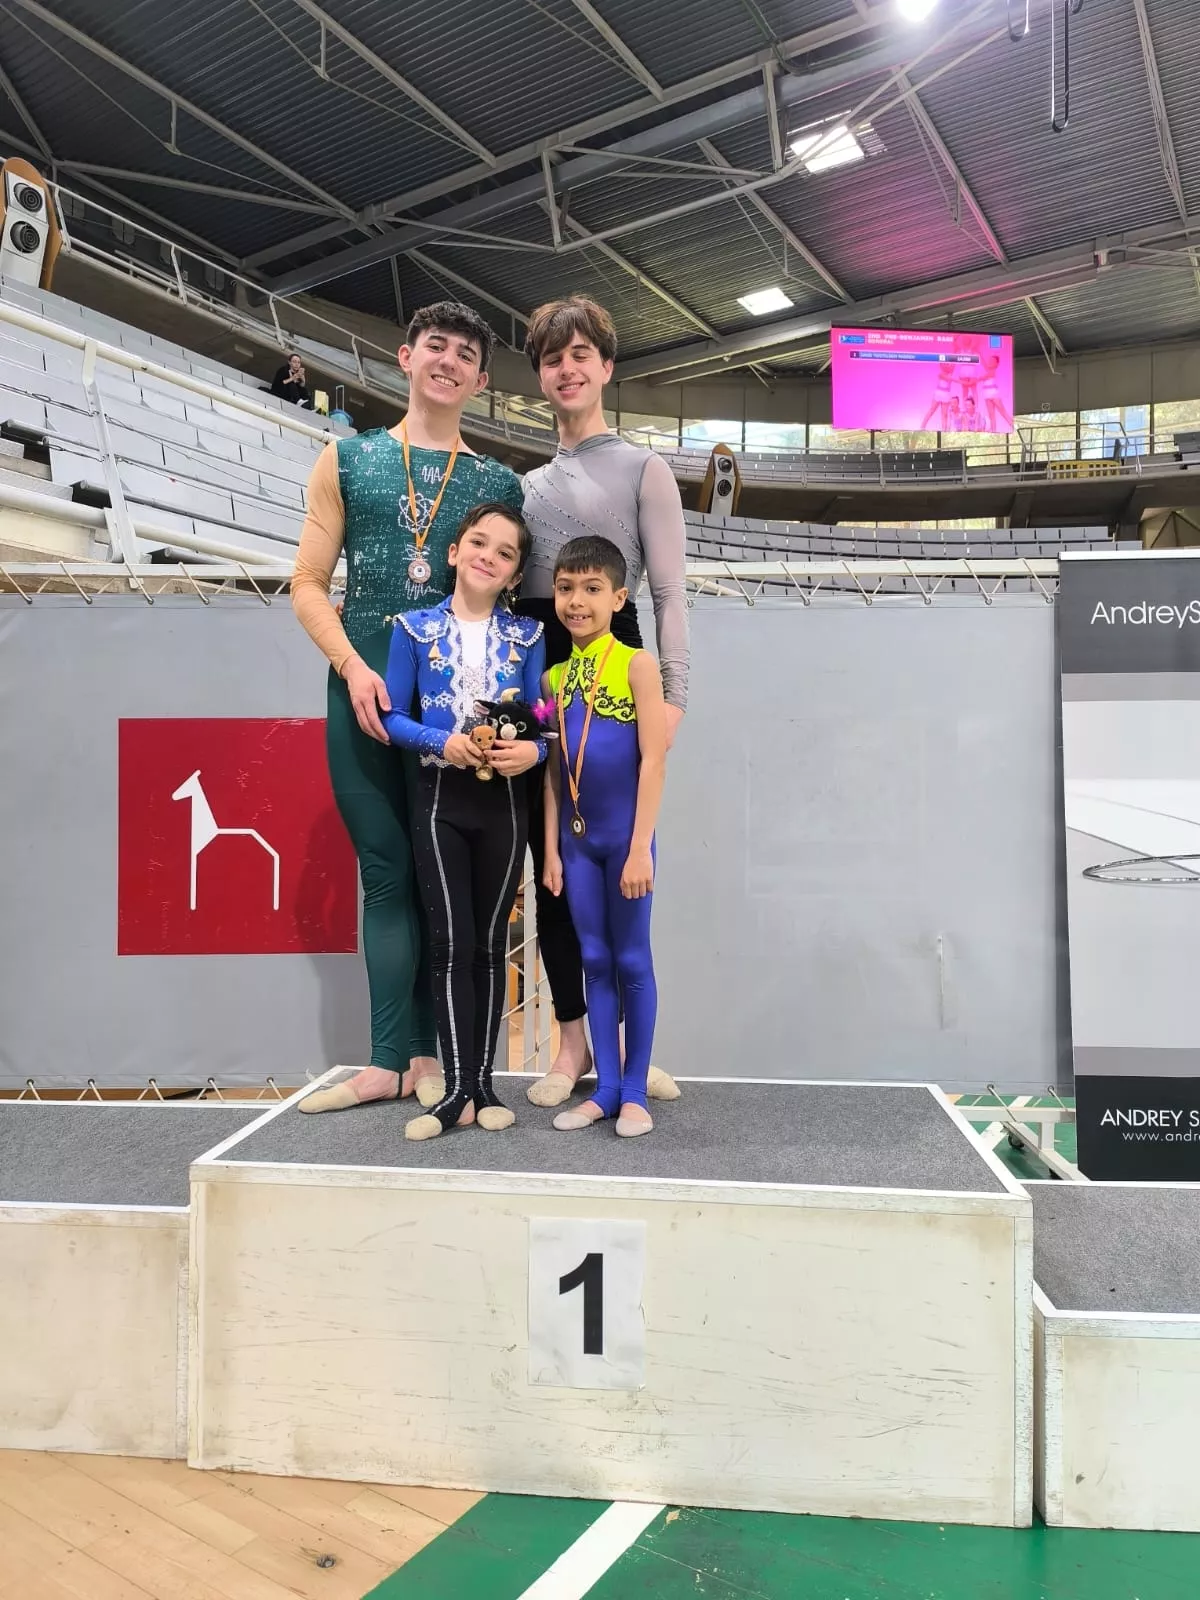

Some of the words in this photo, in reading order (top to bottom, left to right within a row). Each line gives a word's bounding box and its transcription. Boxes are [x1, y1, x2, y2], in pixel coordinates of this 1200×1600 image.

[1100, 1109, 1183, 1127] ANDREY
[1189, 1110, 1200, 1127] S
[1122, 1129, 1200, 1142] www.andr
[559, 1253, 603, 1355] 1
